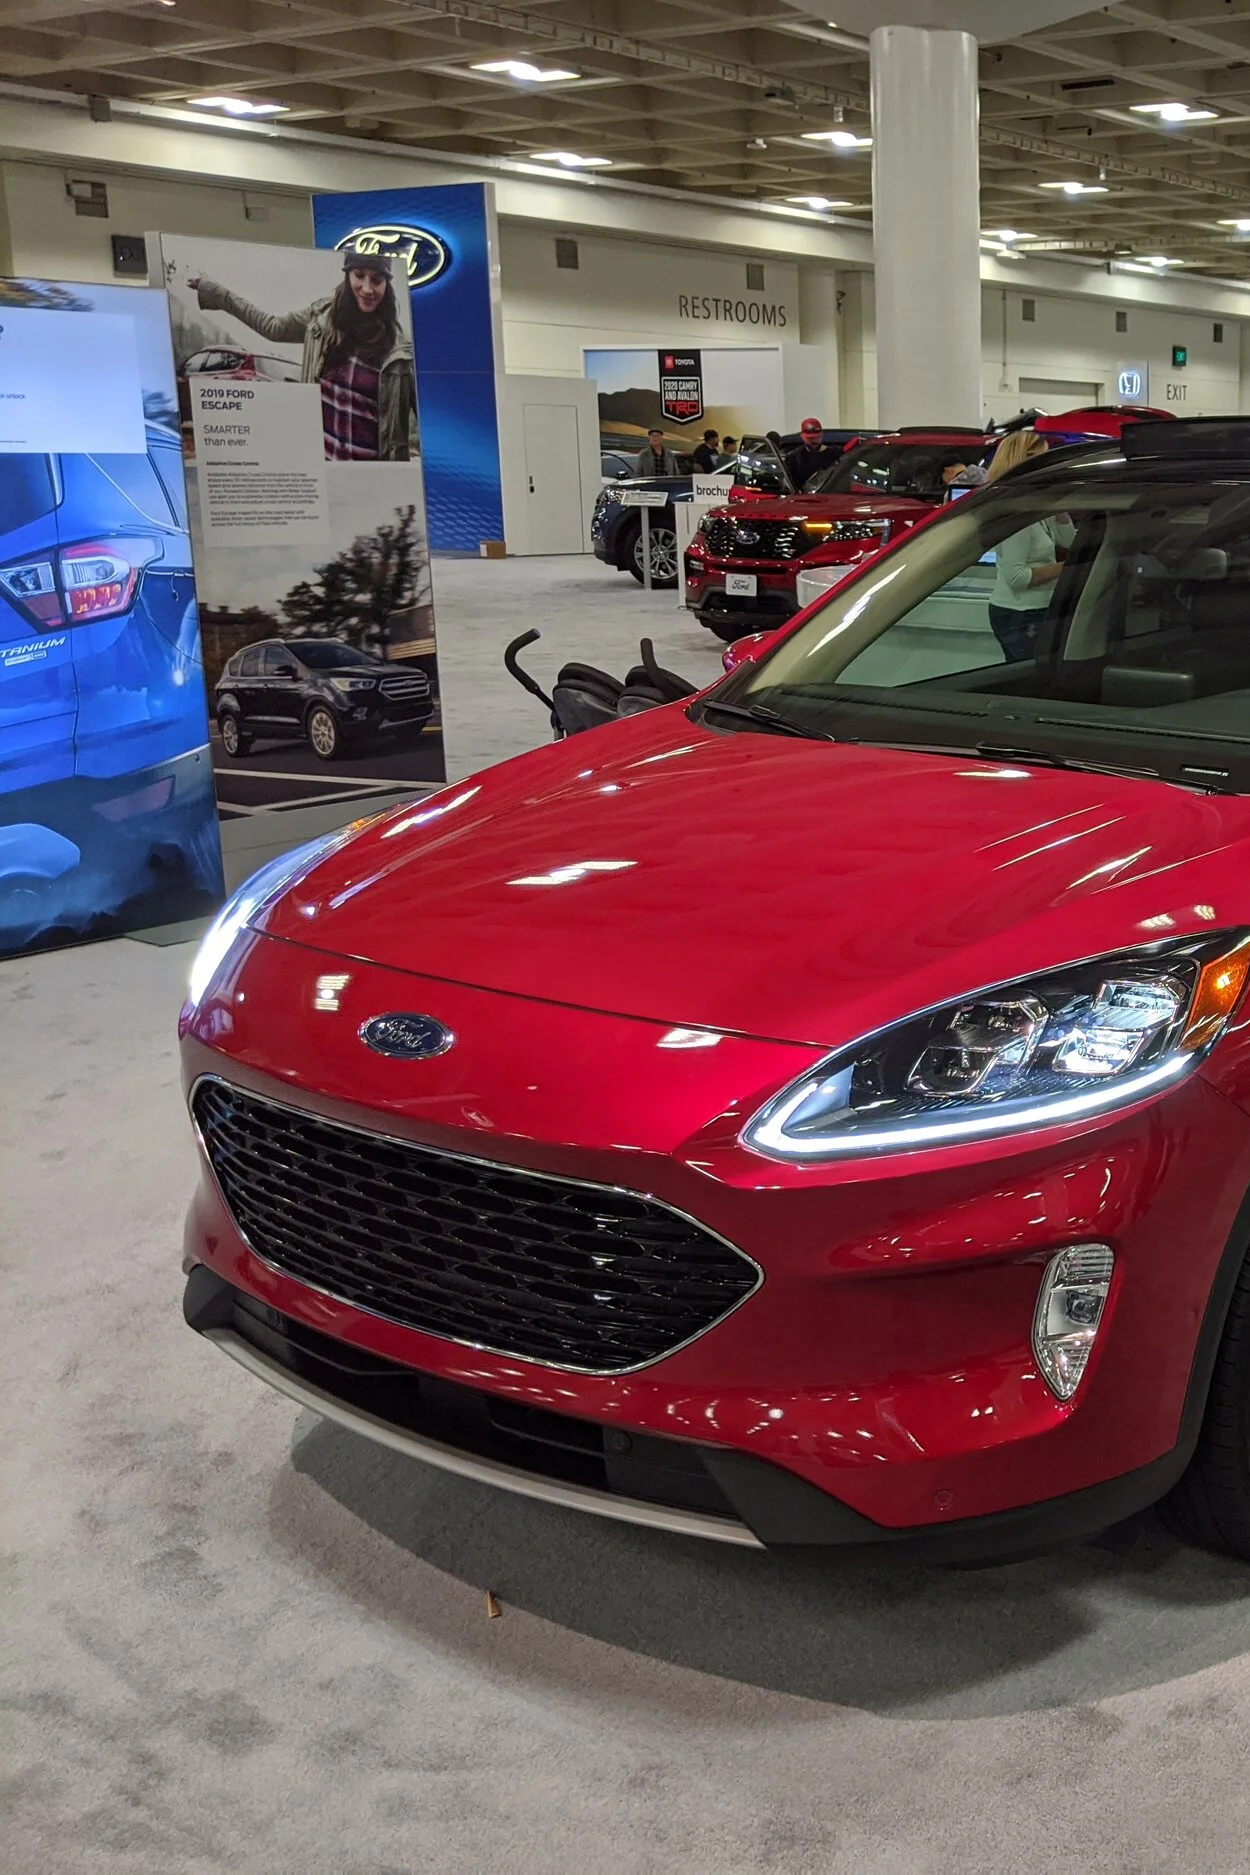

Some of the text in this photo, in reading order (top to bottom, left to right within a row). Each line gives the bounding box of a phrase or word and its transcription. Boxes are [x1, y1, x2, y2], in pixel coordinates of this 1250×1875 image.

[678, 294, 787, 328] RESTROOMS
[664, 381, 698, 391] 2020 CAMRY
[200, 388, 255, 399] 2019 FORD
[665, 391, 699, 401] AND AVALON
[1166, 383, 1188, 401] EXIT
[201, 400, 243, 411] ESCAPE
[665, 401, 699, 415] TRD
[203, 424, 250, 435] SMARTER
[204, 436, 248, 447] than ever.
[731, 579, 751, 591] Ford
[375, 1018, 432, 1049] Ford
